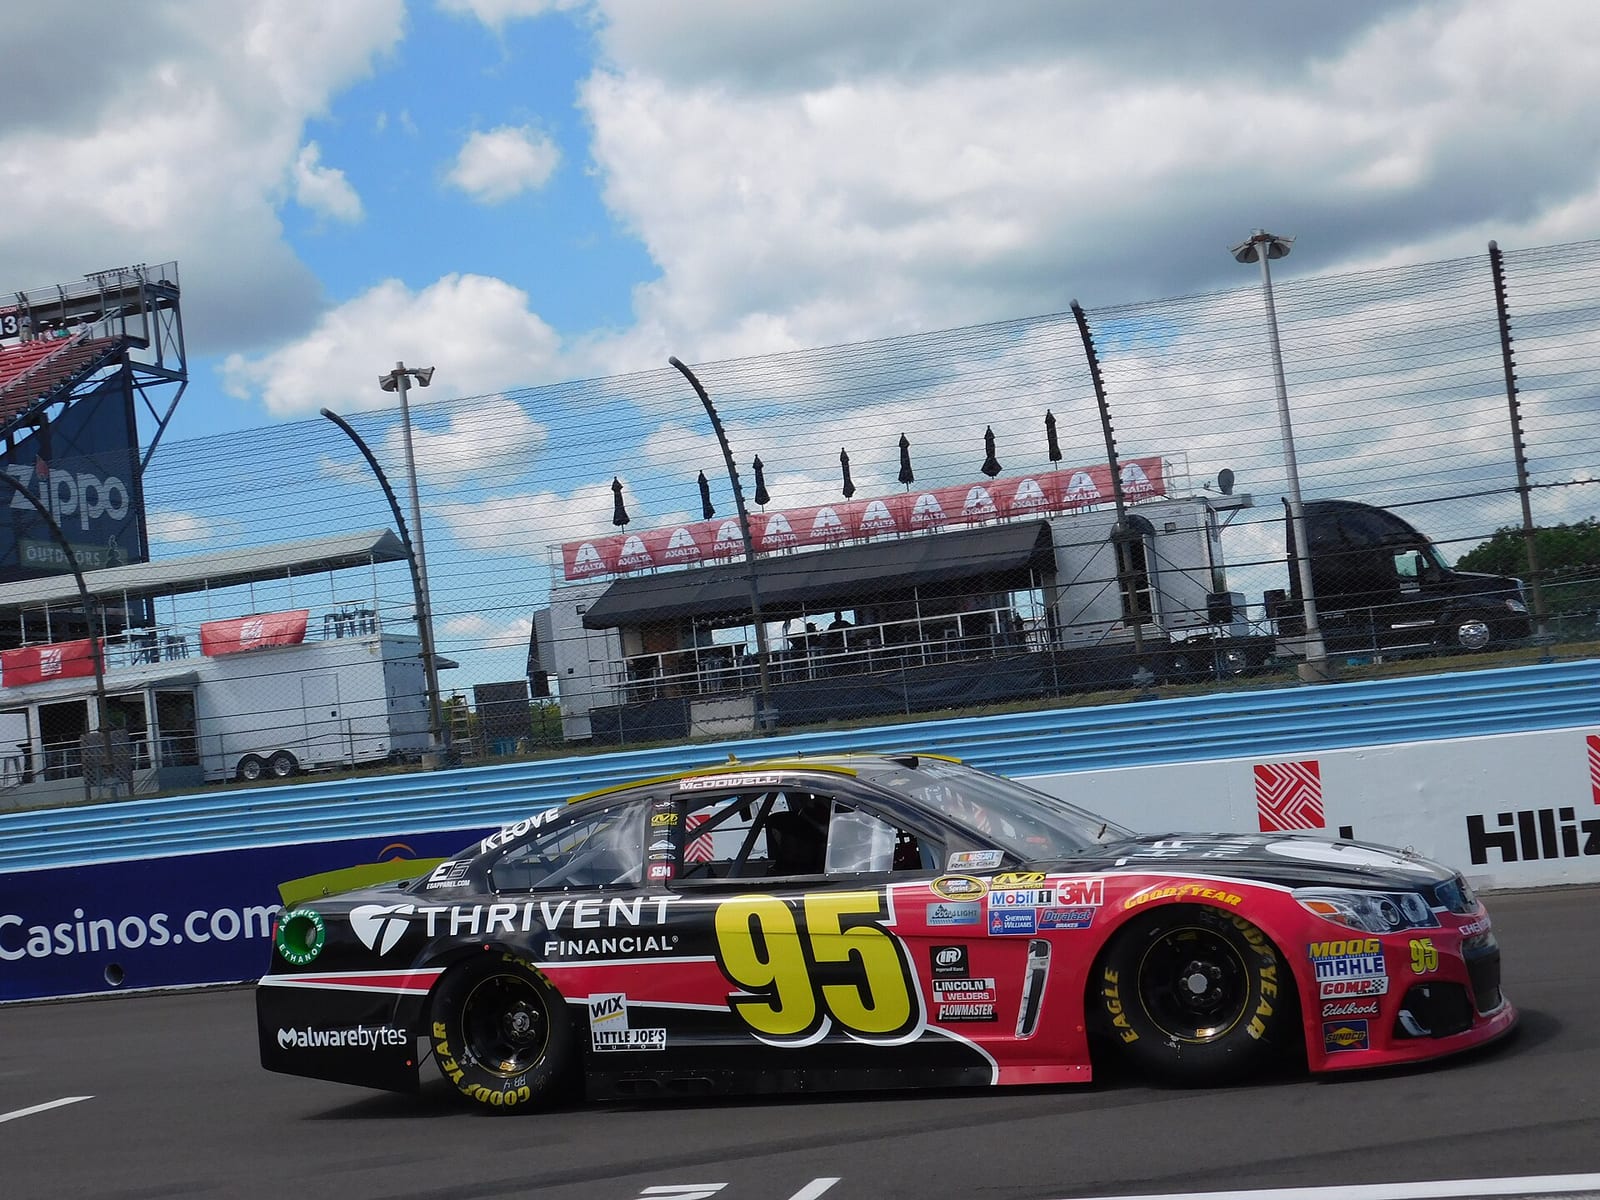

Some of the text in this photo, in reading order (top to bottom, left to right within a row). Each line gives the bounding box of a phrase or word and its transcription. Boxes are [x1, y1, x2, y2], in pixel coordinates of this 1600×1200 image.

[6, 463, 129, 531] Zippo
[1011, 497, 1050, 509] AXALTA
[1063, 490, 1101, 502] AXALTA
[911, 512, 947, 522] AXALTA
[961, 504, 998, 516] AXALTA
[810, 526, 847, 538] AXALTA
[860, 519, 896, 531] AXALTA
[762, 533, 797, 545] AXALTA
[26, 545, 100, 566] OUTDORS
[618, 554, 652, 566] AXALTA
[664, 547, 701, 558] AXALTA
[572, 562, 606, 574] AXALTA
[651, 866, 671, 877] SEM
[992, 890, 1034, 904] Mobil
[1058, 881, 1101, 905] 3M
[279, 909, 324, 932] AMERICAN
[417, 895, 683, 937] THRIVENT
[957, 910, 977, 918] LIGHT
[0, 904, 285, 960] Casinos.com
[279, 942, 323, 963] ETHANOL
[1309, 938, 1380, 958] MOOG
[714, 890, 912, 1038] 95
[1409, 938, 1438, 975] 95
[1315, 957, 1384, 978] MAHLE
[936, 981, 984, 991] LINCOLN
[1323, 980, 1372, 995] COMP
[947, 992, 990, 1000] WELDERS
[591, 996, 624, 1018] WIX
[939, 1004, 993, 1020] FLOWMASTER
[1104, 966, 1140, 1044] EAGLE
[1322, 1002, 1378, 1017] Edelbrock
[277, 1025, 407, 1051] Malwarebytes
[594, 1030, 665, 1044] LITTLE JOE'S
[1326, 1032, 1366, 1041] SUNOCO
[432, 1021, 530, 1106] GOODYEAR
